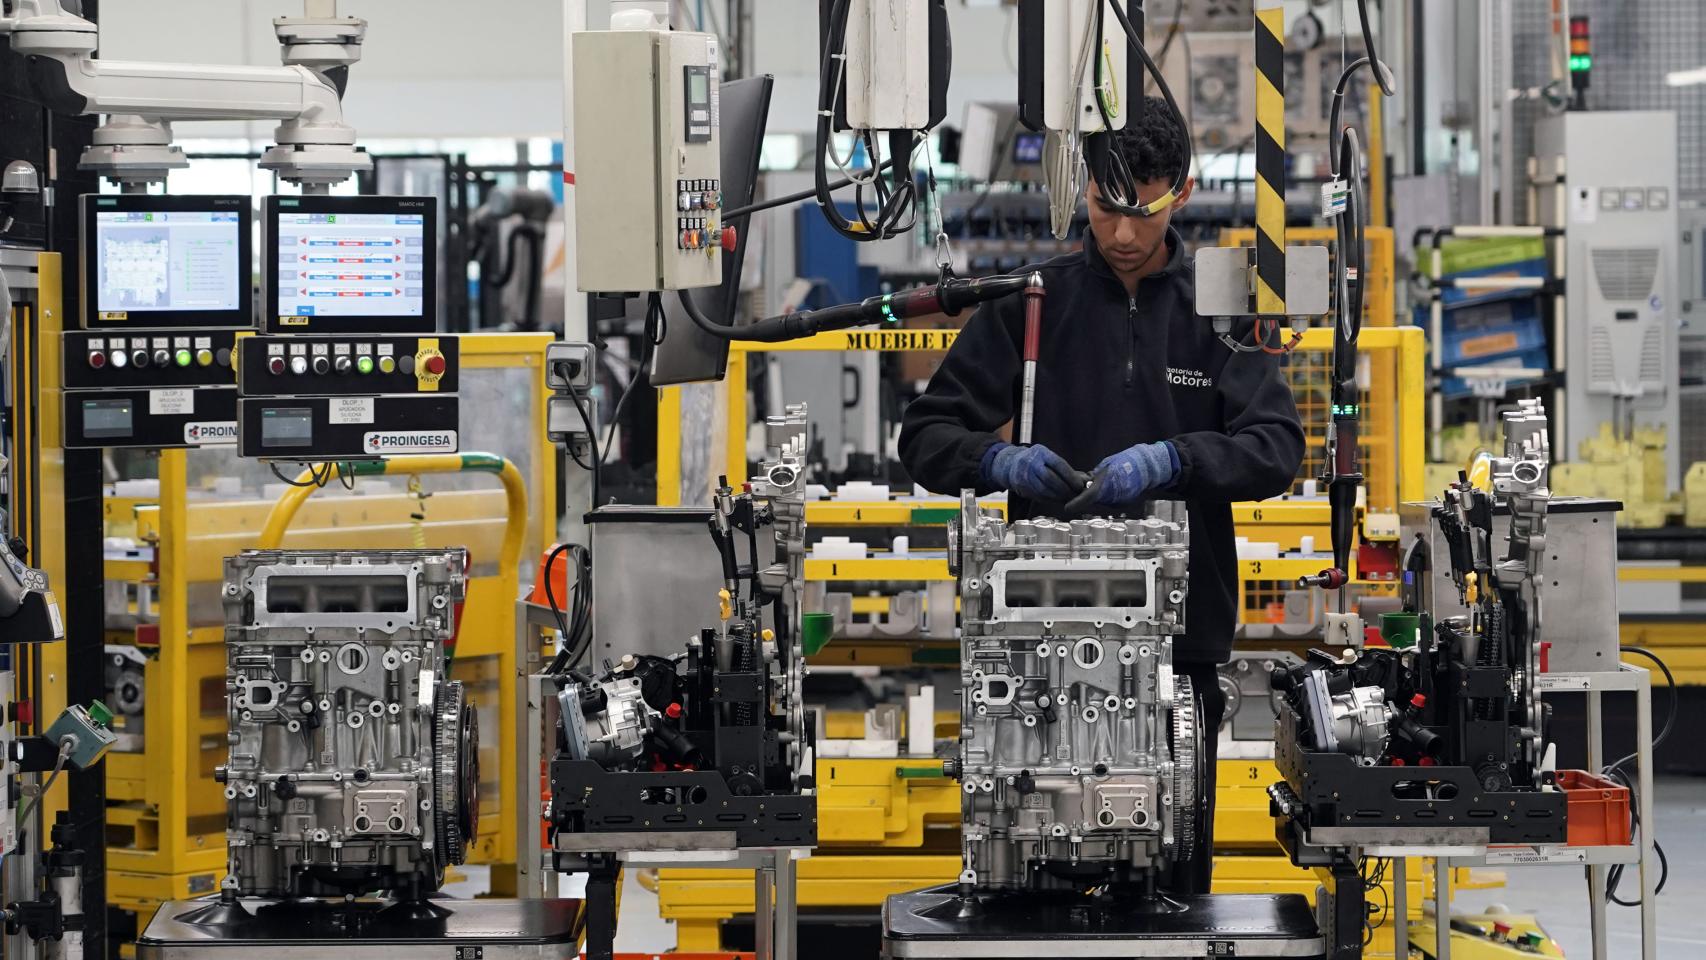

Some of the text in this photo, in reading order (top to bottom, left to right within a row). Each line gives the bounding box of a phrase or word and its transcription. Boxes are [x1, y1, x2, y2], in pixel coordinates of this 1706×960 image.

[846, 333, 960, 350] MUEBLE F
[1166, 372, 1212, 387] Motores
[200, 426, 237, 437] PROIN
[381, 435, 451, 446] PROINGESA
[853, 509, 861, 520] 4
[1253, 509, 1262, 520] 6
[1250, 561, 1261, 573] 3
[1249, 767, 1258, 779] 3
